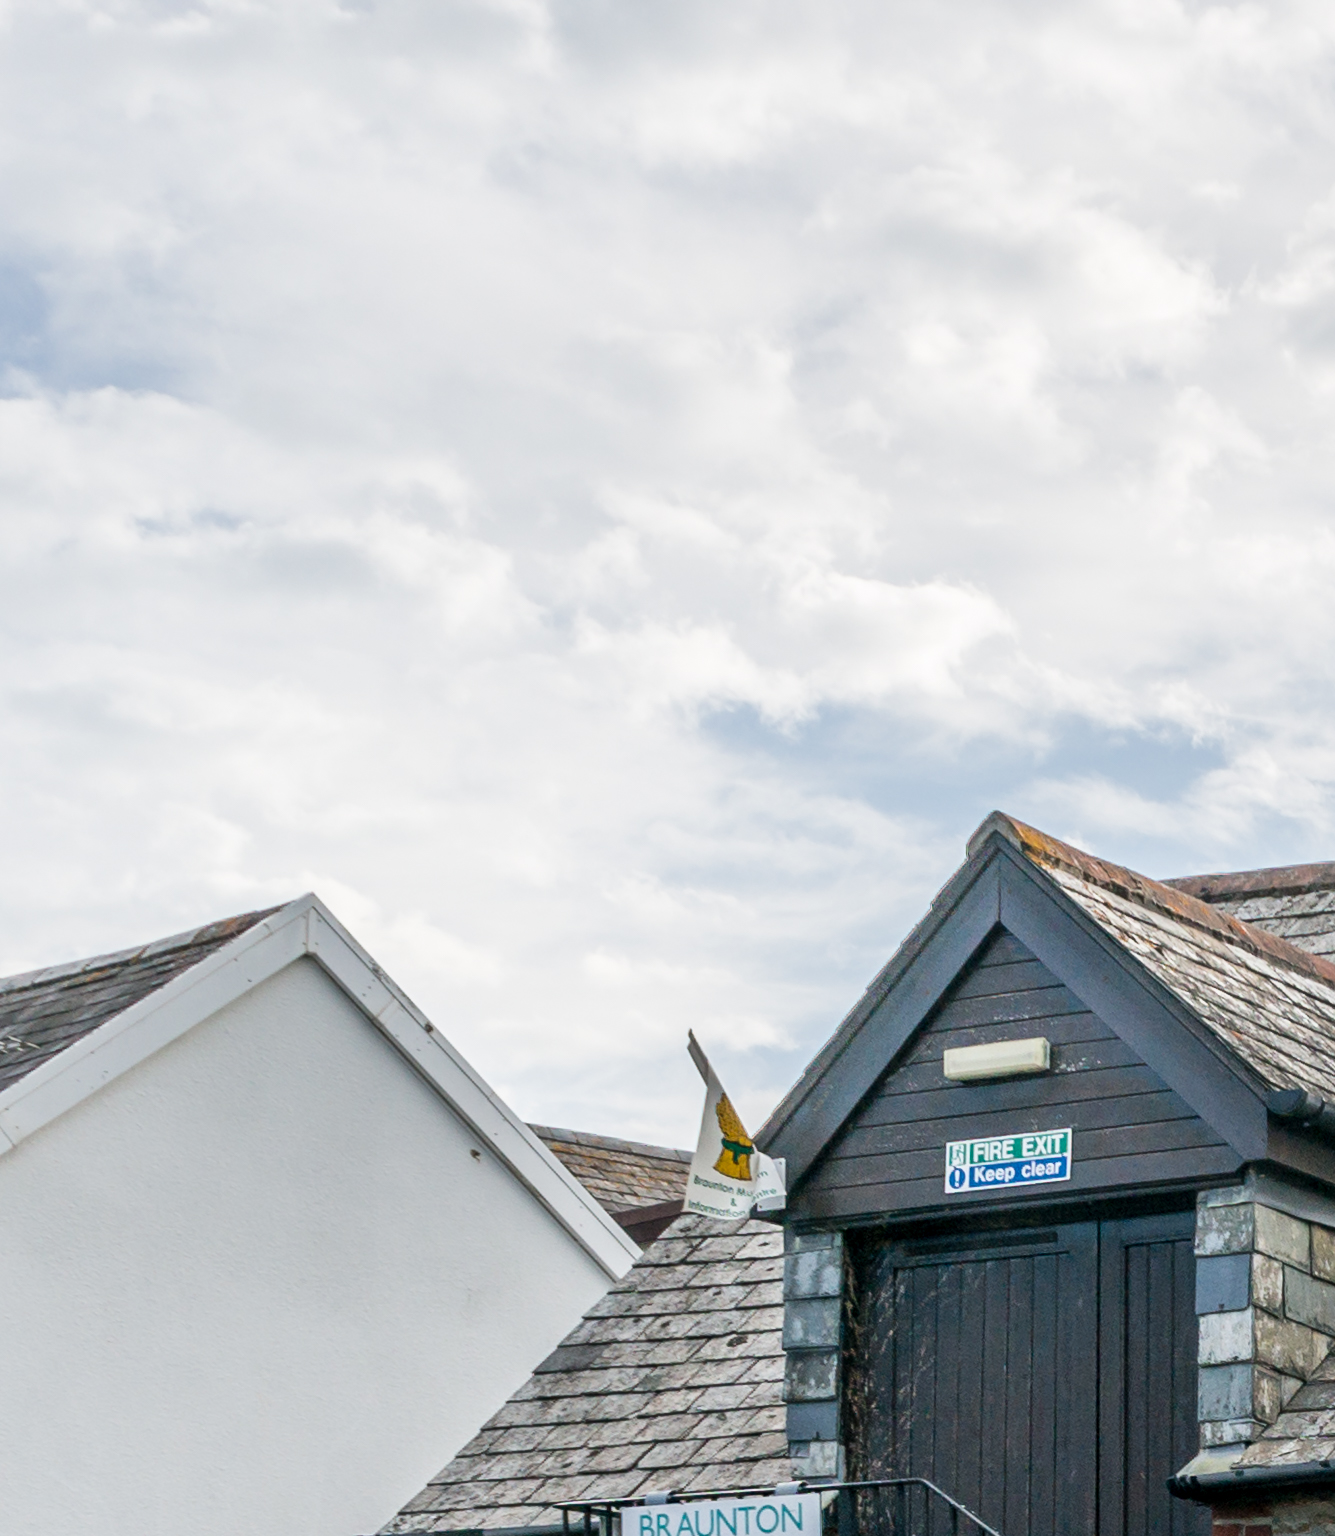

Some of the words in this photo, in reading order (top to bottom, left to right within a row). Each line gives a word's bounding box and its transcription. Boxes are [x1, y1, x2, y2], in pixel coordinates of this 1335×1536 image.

[973, 1139, 1015, 1163] FIRE
[1022, 1133, 1064, 1156] EXIT
[974, 1165, 1015, 1183] Keep
[1021, 1160, 1062, 1178] clear
